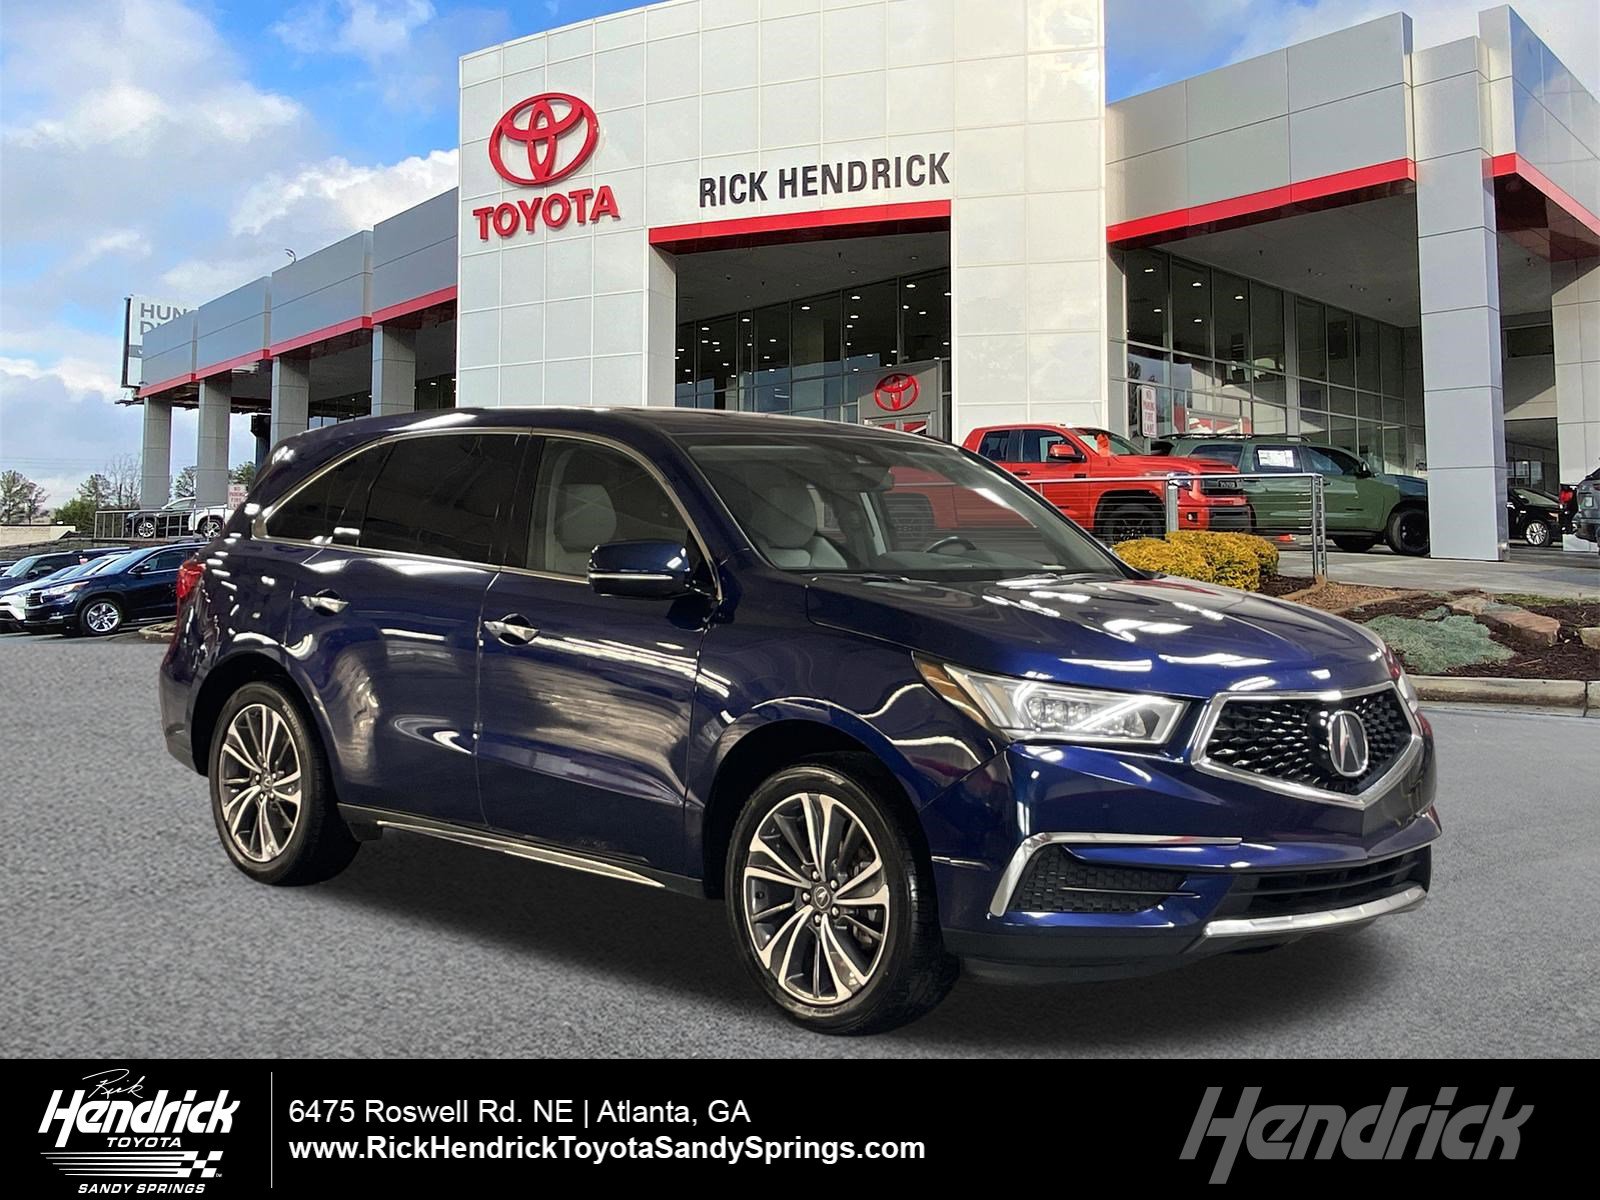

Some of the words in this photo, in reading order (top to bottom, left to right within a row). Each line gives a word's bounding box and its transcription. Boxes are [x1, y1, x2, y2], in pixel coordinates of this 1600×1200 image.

[699, 170, 768, 208] RICK
[778, 152, 950, 200] HENDRICK
[472, 185, 621, 241] TOYOTA
